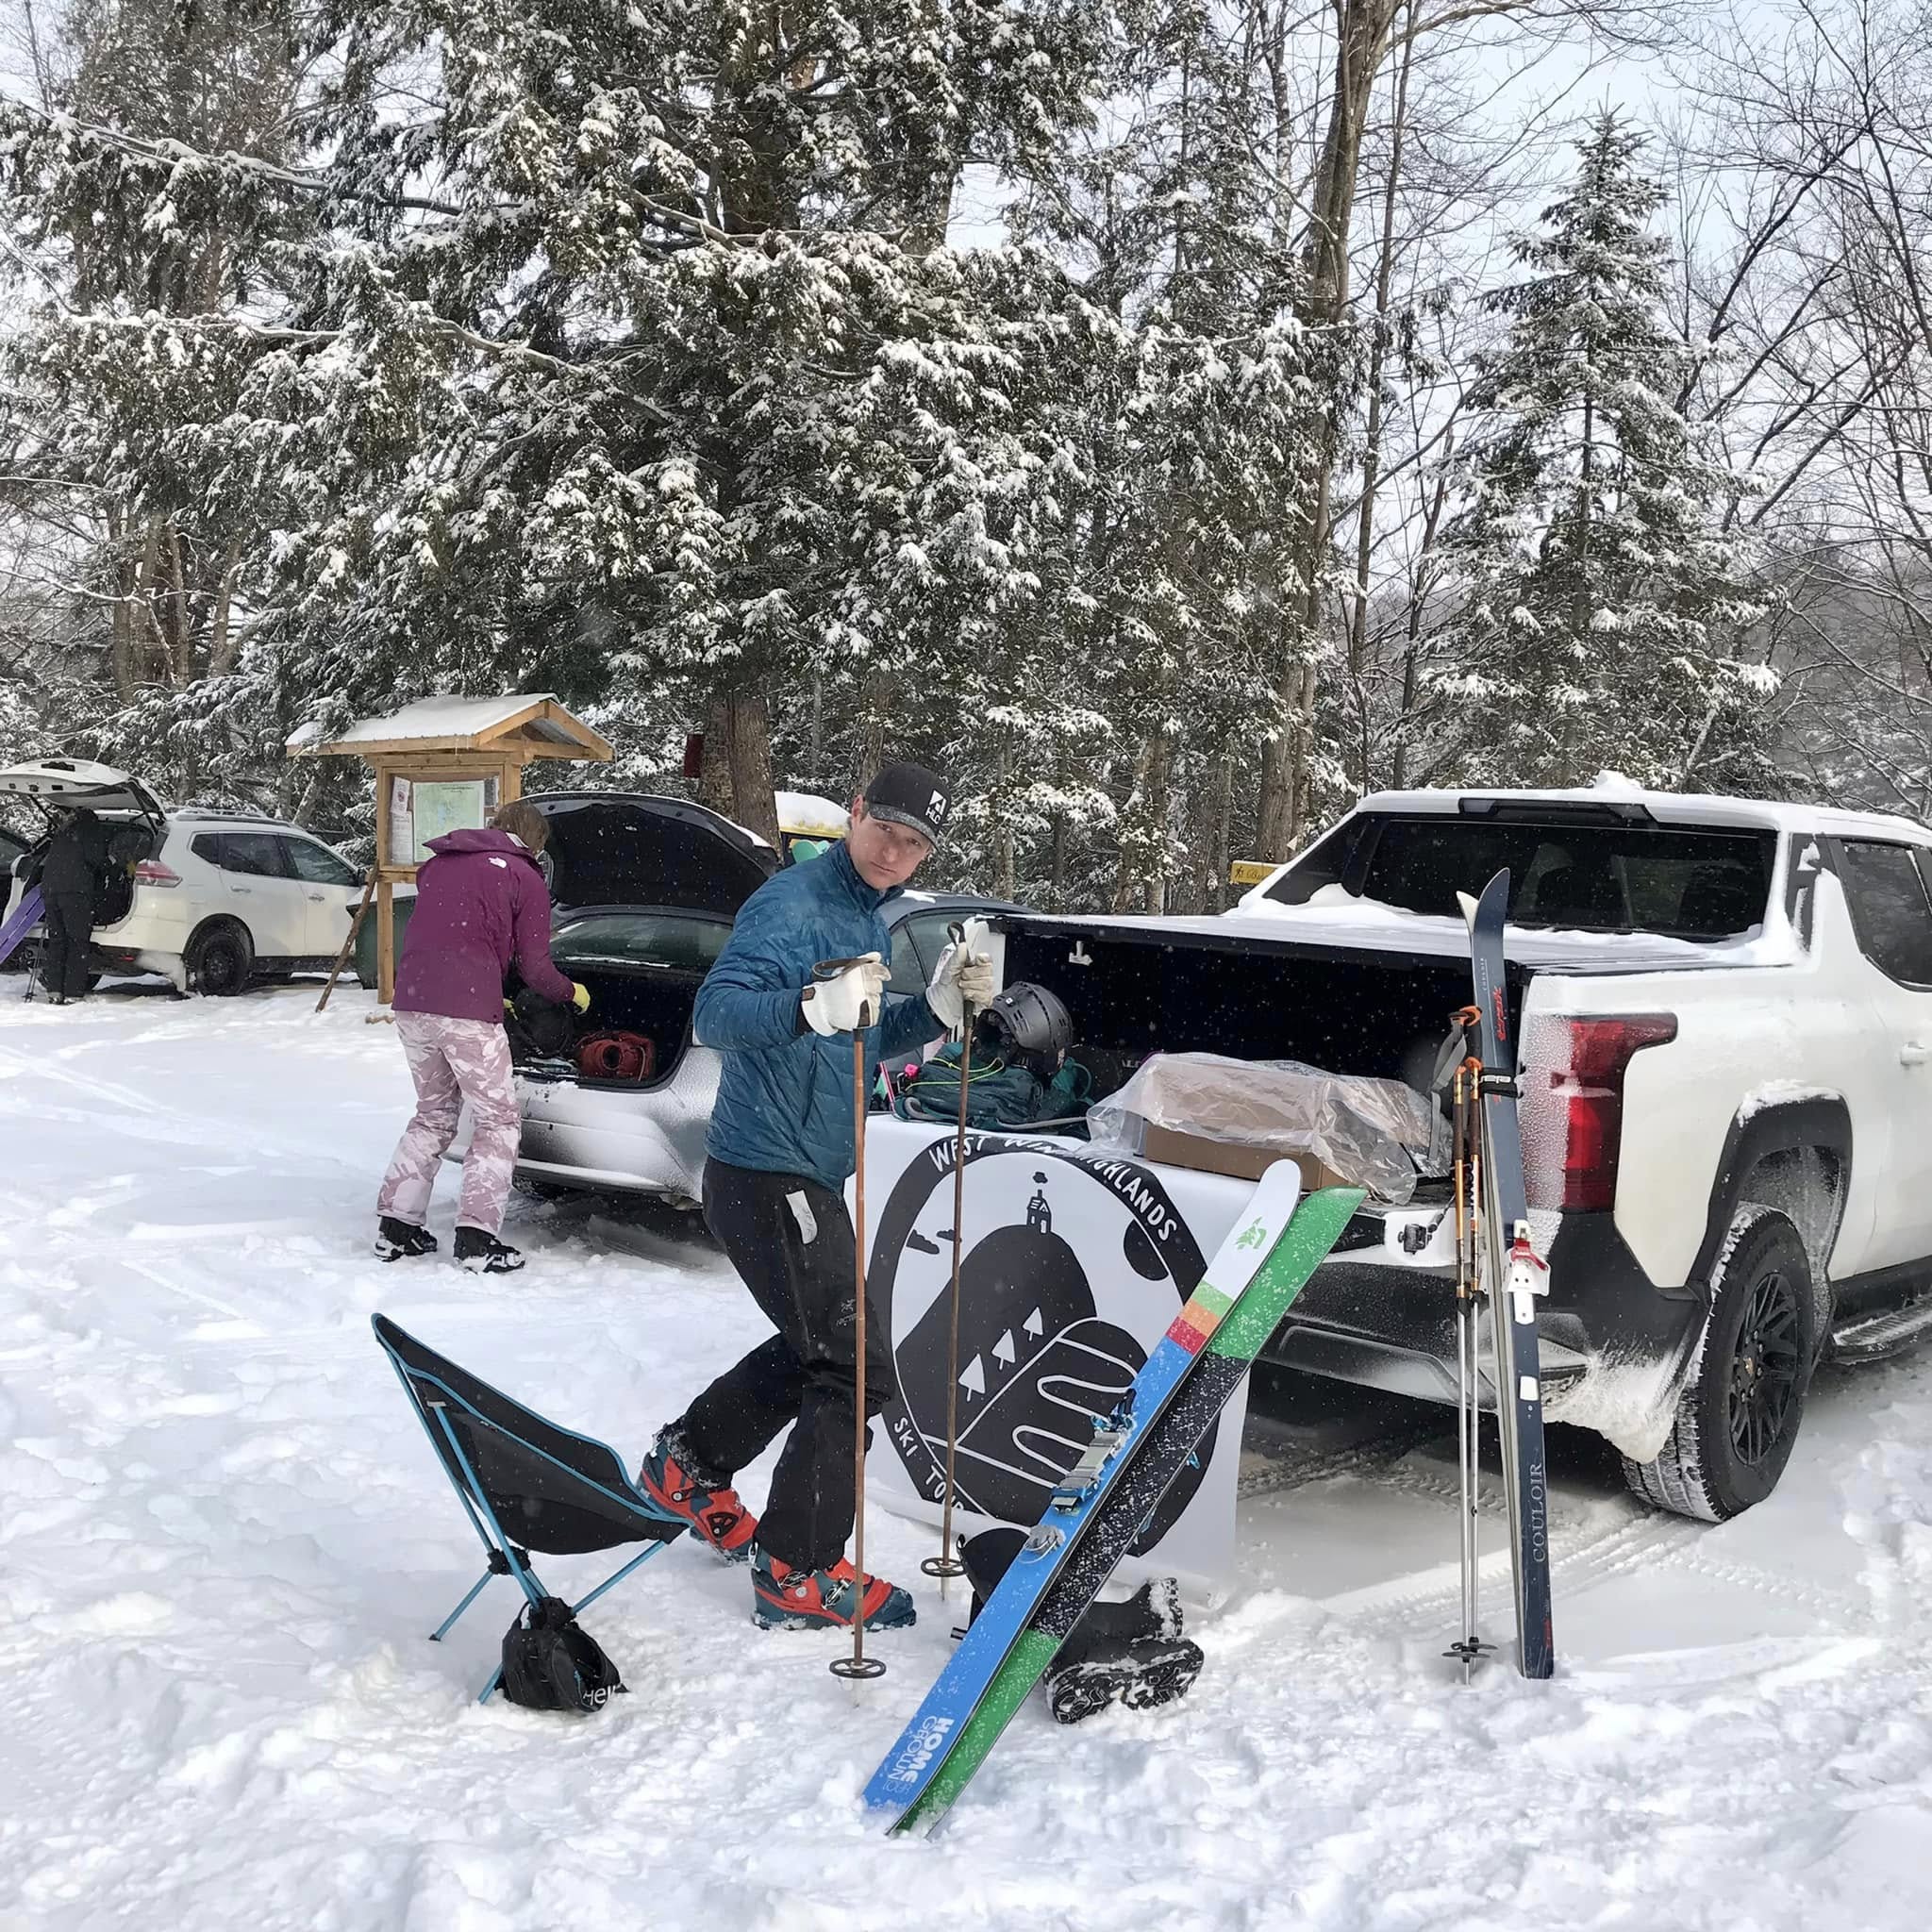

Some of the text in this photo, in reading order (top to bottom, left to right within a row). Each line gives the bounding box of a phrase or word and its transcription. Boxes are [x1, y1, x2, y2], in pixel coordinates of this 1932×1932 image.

[893, 1417, 918, 1457] SKI
[1529, 1462, 1547, 1563] COULOIR
[900, 1717, 955, 1784] HOME
